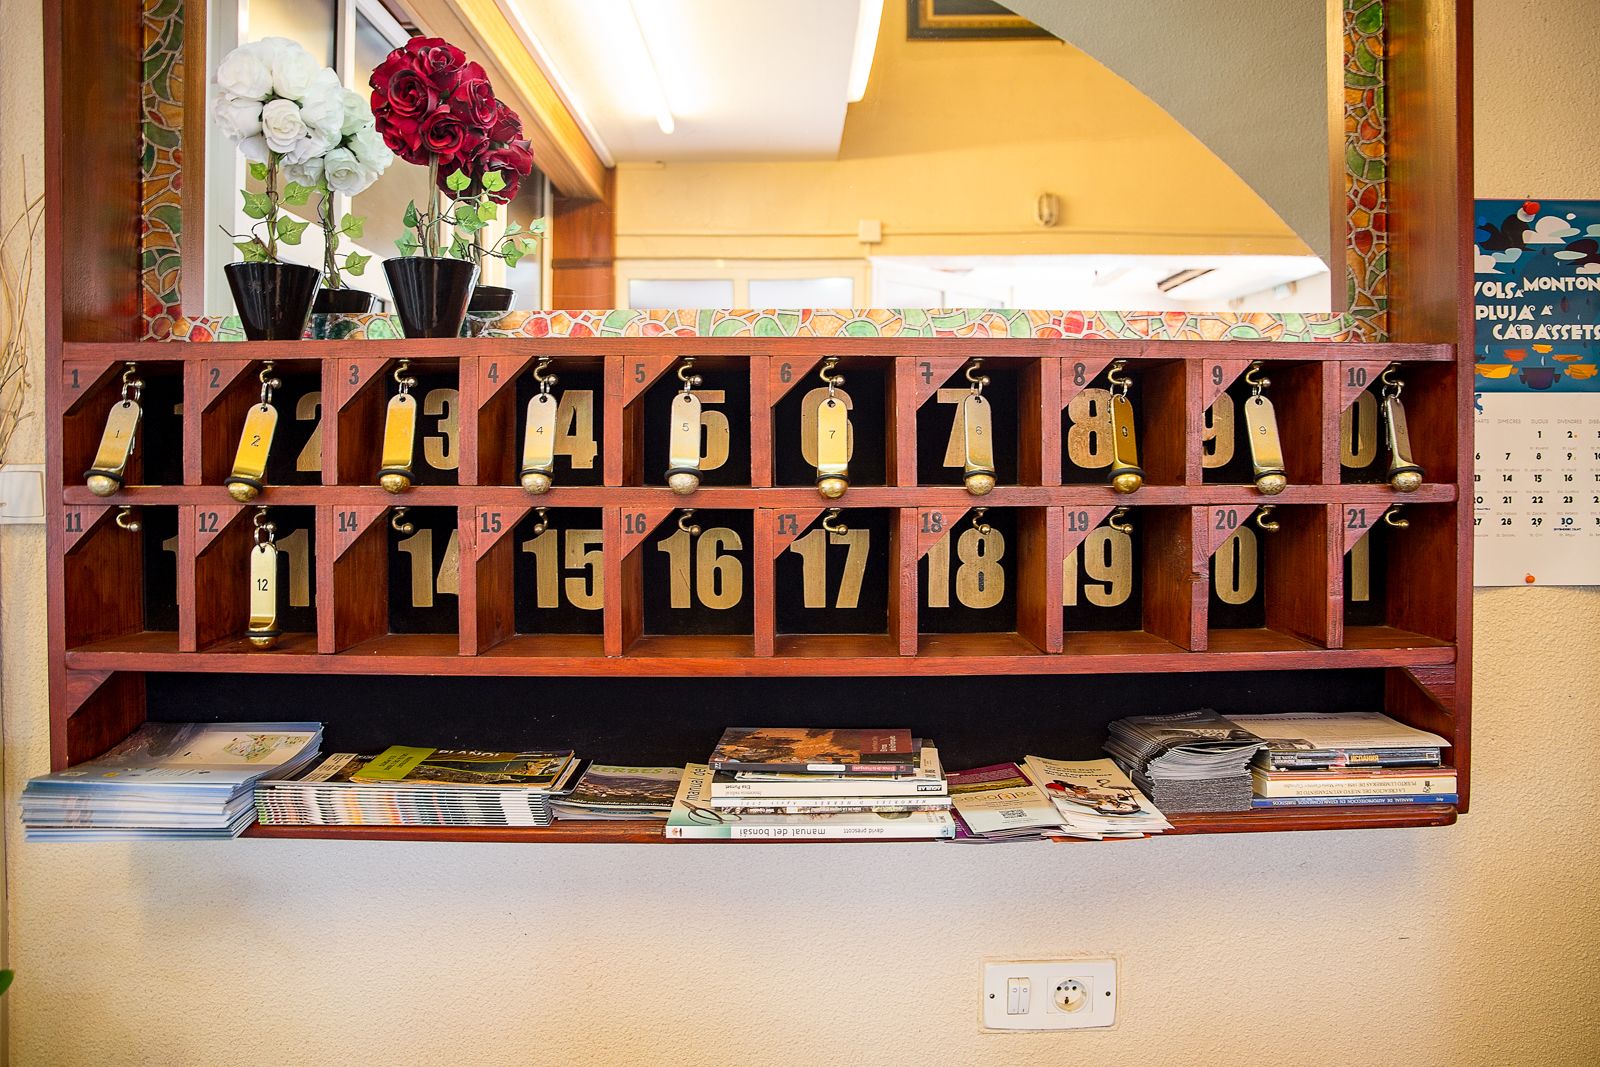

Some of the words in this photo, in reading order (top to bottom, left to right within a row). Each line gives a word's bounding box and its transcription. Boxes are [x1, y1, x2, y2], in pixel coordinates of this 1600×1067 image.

[1475, 305, 1536, 322] PLUJA
[1492, 324, 1600, 340] CABASSETS
[72, 368, 80, 388] 1
[210, 368, 220, 388] 2
[349, 365, 359, 385] 3
[488, 363, 499, 383] 4
[635, 364, 646, 383] 5
[781, 363, 792, 383] 6
[920, 362, 934, 384] 7
[1074, 362, 1085, 386] 8
[1212, 365, 1223, 385] 9
[1348, 367, 1366, 387] 10
[424, 388, 460, 470] 3
[536, 426, 543, 435] 4
[554, 390, 598, 469] 4
[682, 423, 689, 432] 5
[829, 430, 836, 439] 7
[976, 426, 982, 435] 6
[1068, 388, 1114, 468] 8
[251, 435, 260, 447] 2
[66, 512, 83, 532] 11
[199, 512, 219, 532] 12
[339, 512, 358, 532] 14
[480, 512, 502, 532] 15
[625, 513, 646, 534] 16
[778, 514, 798, 535] 17
[921, 512, 942, 533] 18
[1068, 511, 1088, 531] 19
[1216, 510, 1237, 529] 20
[1347, 508, 1367, 528] 21
[522, 529, 604, 610] 15
[657, 527, 743, 610] 16
[790, 529, 870, 608] 17
[927, 527, 1005, 609] 18
[257, 578, 268, 591] 12
[739, 828, 770, 837] bonsái
[774, 828, 788, 837] del
[792, 828, 826, 837] manual
